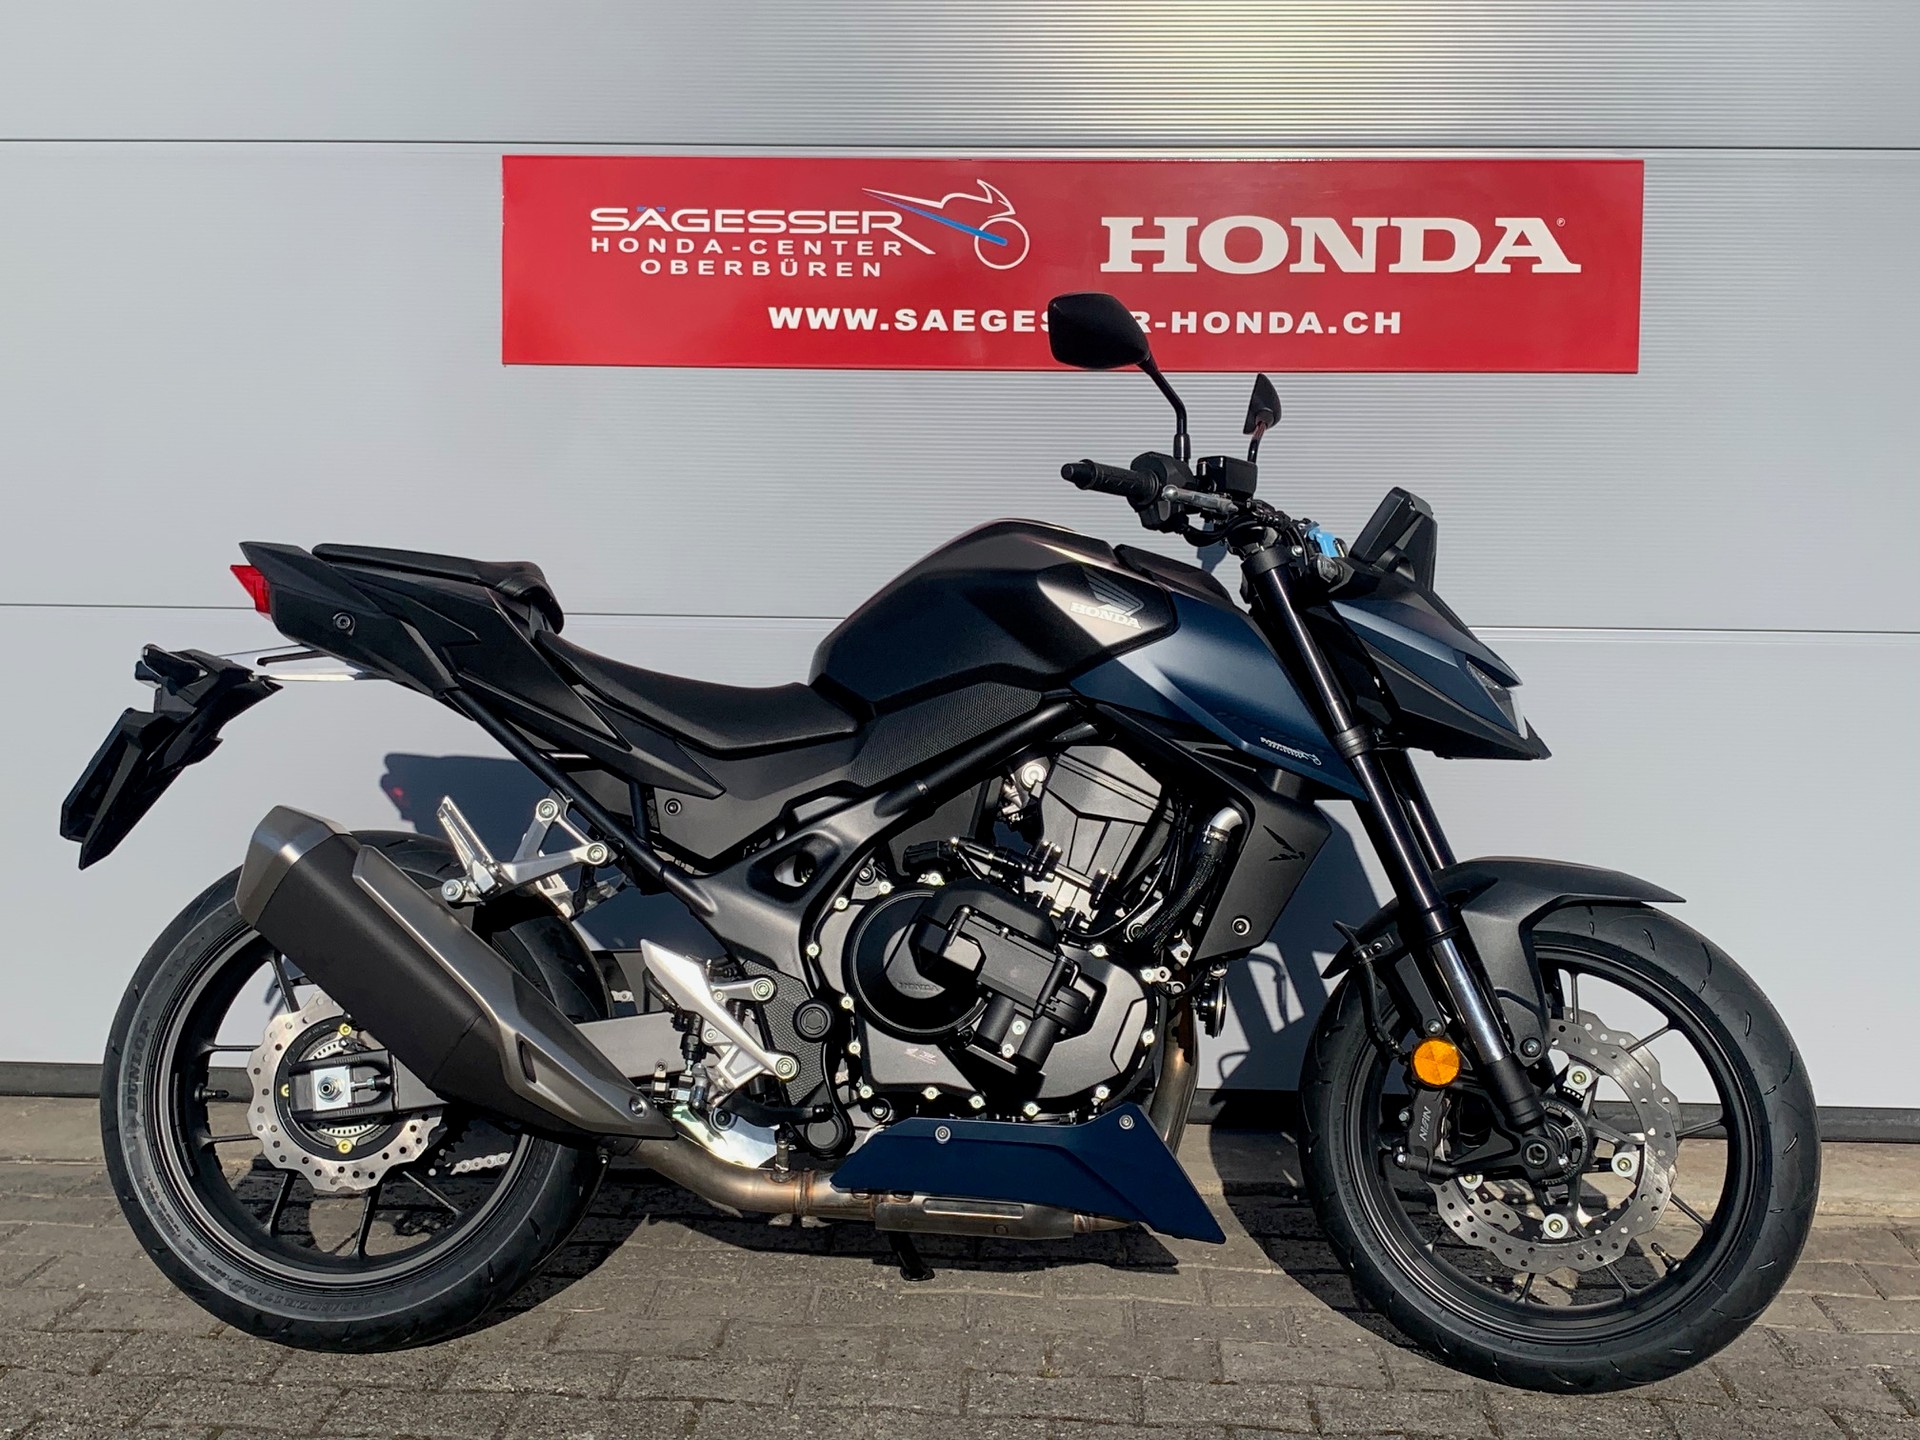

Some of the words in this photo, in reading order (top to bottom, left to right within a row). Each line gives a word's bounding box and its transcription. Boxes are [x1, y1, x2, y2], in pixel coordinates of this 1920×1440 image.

[590, 205, 937, 255] SÄGESSER
[590, 236, 903, 257] HONDA-CENTER
[1100, 215, 1582, 275] HONDA
[640, 258, 882, 278] OBERBÜREN
[767, 306, 1402, 335] WWW.SAEGER-HONDA.CH
[1069, 602, 1142, 630] HONDA
[895, 982, 940, 993] HONDA
[126, 1020, 150, 1112] DUNLOP
